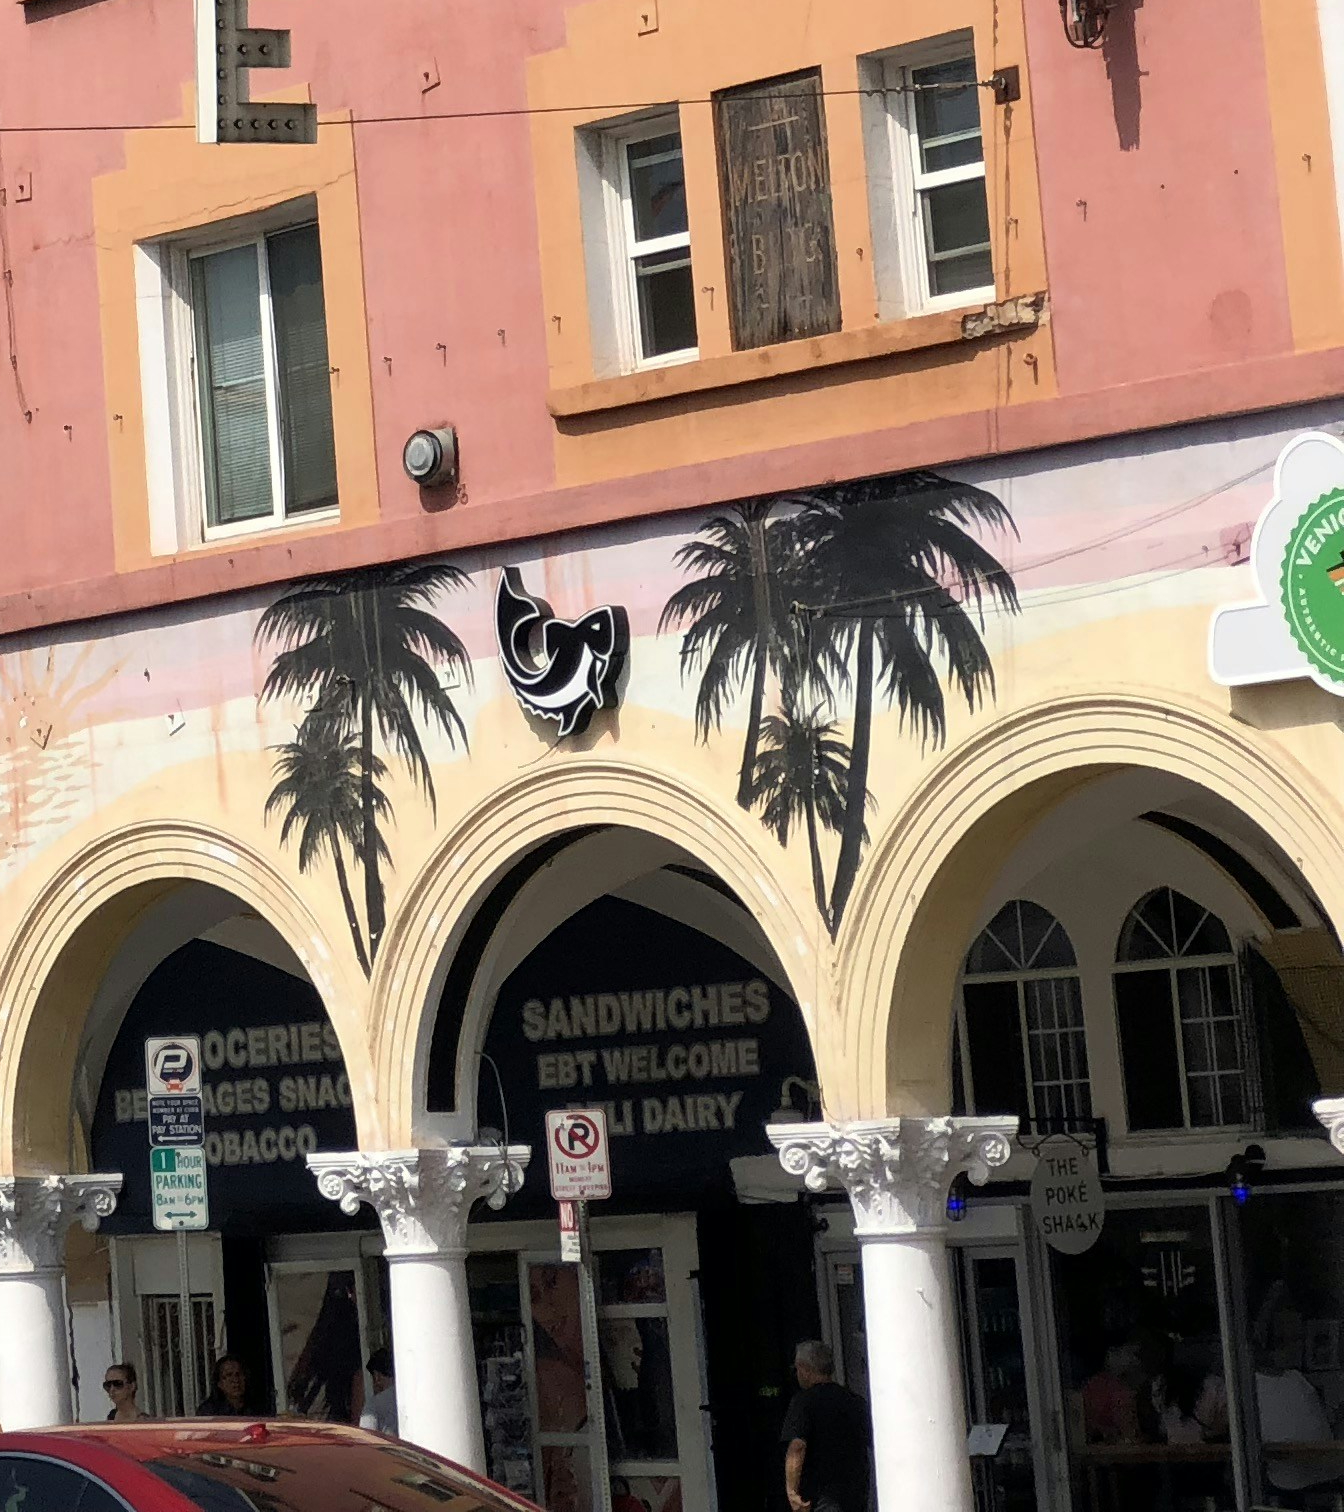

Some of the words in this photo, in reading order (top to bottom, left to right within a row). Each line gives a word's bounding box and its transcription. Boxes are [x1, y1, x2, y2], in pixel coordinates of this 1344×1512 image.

[522, 978, 771, 1042] SANDWICHES
[201, 1021, 342, 1071] OCERIES
[537, 1048, 598, 1090] EBT
[601, 1039, 761, 1086] WELCOME
[115, 1077, 271, 1123] BEAGES
[279, 1073, 352, 1113] SNAC
[162, 1114, 177, 1124] PAY
[180, 1113, 190, 1123] AT
[642, 1090, 745, 1135] DAIRY
[152, 1125, 167, 1134] PAY
[169, 1124, 202, 1135] STATION
[205, 1124, 318, 1166] OBACCO
[160, 1151, 167, 1169] 1
[177, 1156, 202, 1169] HOUR
[1046, 1157, 1078, 1177] THE
[155, 1173, 203, 1189] PARKING
[1045, 1180, 1088, 1206] POKÉ
[155, 1193, 176, 1206] 8AM
[184, 1192, 204, 1206] 6PM
[1042, 1213, 1101, 1235] SHACK
